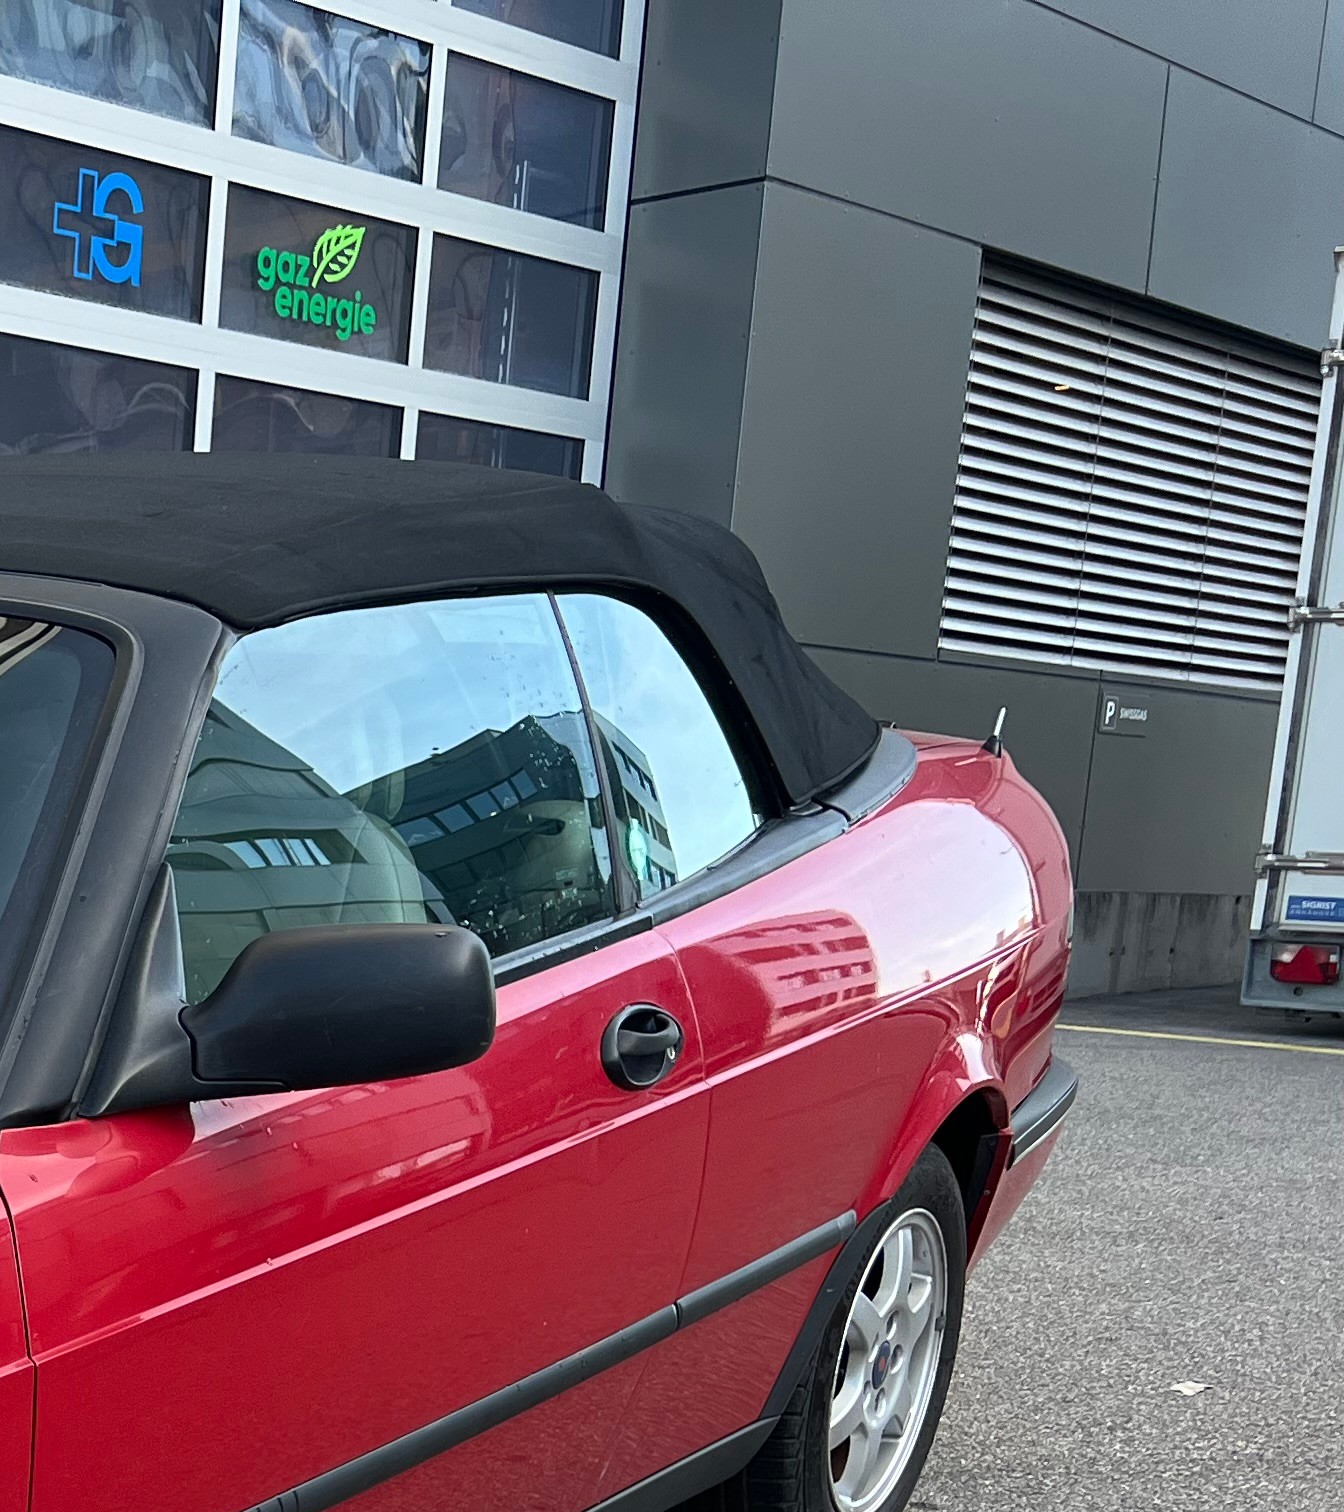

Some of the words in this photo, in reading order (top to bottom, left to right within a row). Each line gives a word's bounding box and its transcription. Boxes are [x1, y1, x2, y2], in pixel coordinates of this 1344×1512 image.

[257, 246, 310, 291] gaz
[274, 286, 376, 341] energie
[1105, 701, 1116, 725] P
